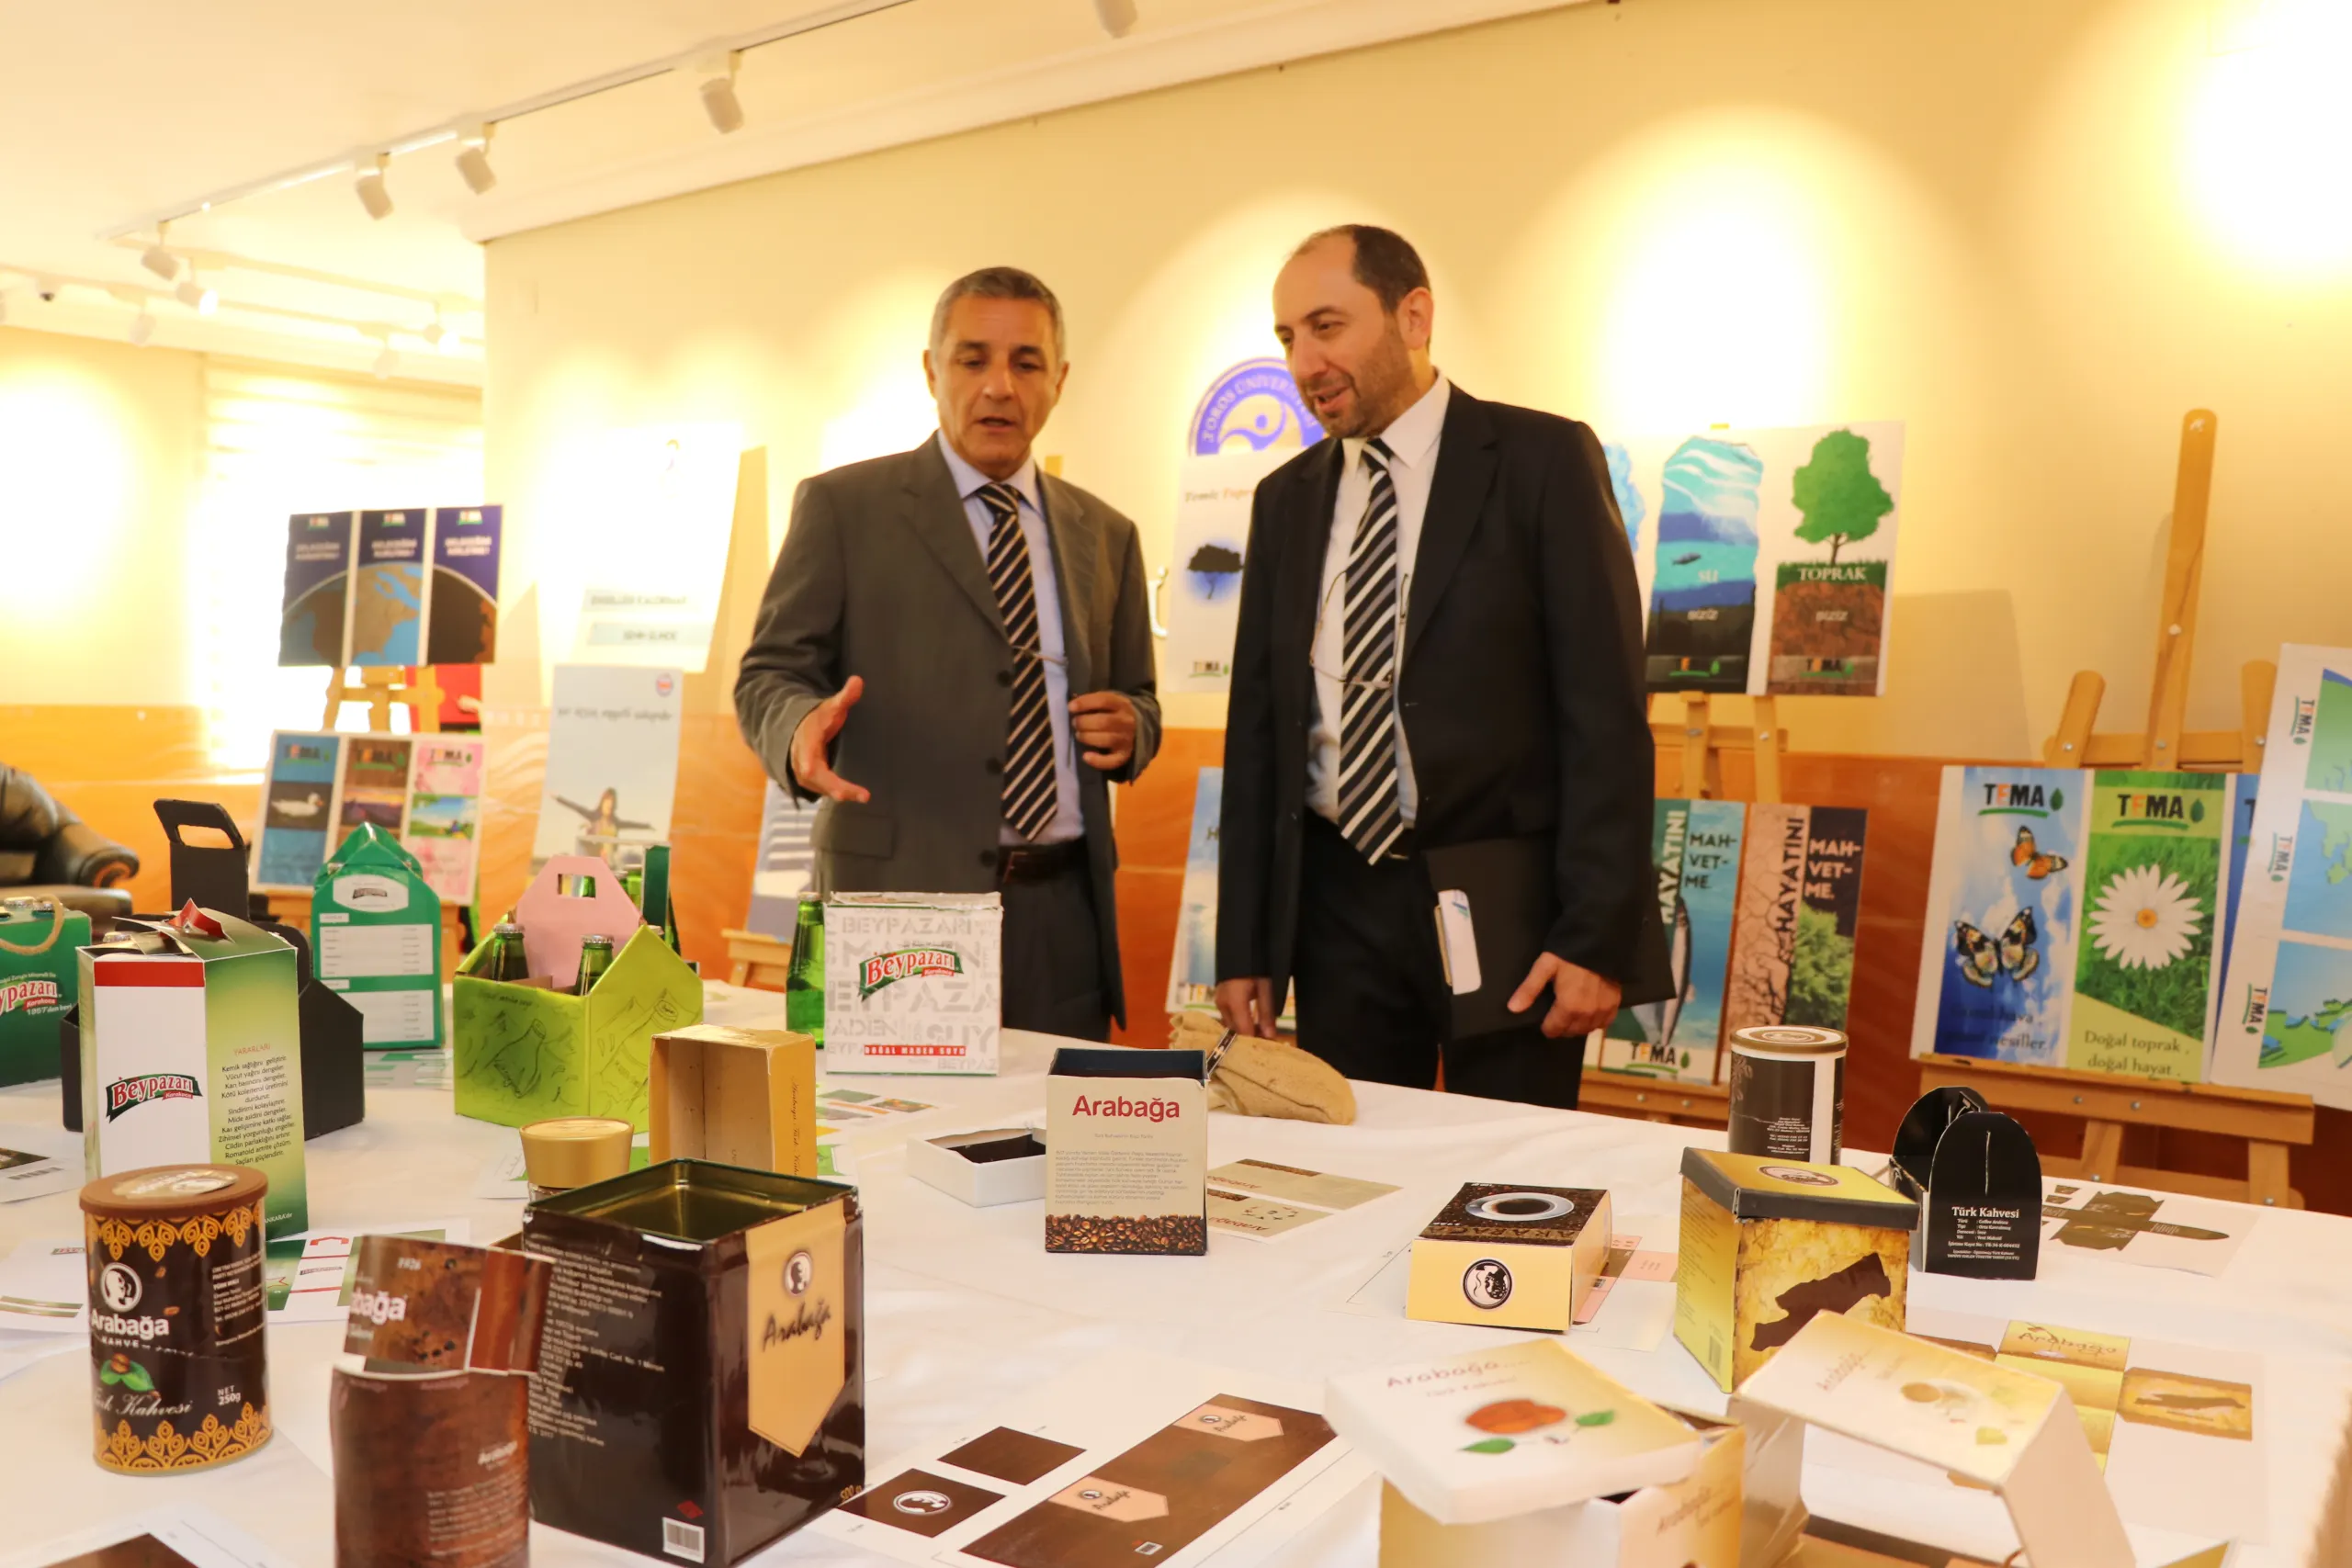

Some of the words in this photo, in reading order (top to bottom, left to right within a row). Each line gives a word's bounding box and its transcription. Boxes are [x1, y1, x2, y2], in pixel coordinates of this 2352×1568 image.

[1797, 568, 1867, 581] TOPRAK
[2296, 699, 2315, 735] TEMA
[1984, 784, 2045, 807] TEMA
[2117, 794, 2184, 819] TEMA
[1689, 833, 1737, 849] MAH-
[1808, 839, 1861, 857] MAH-
[1689, 853, 1728, 869] VET-
[2274, 835, 2294, 873] TEMA
[1775, 818, 1805, 935] HAYATINI
[1808, 861, 1854, 879] VET-
[1805, 883, 1835, 899] ME.
[865, 951, 956, 987] Beypazarı
[2249, 987, 2268, 1025] TEMA
[2085, 1030, 2127, 1050] Doğal
[2132, 1035, 2180, 1055] toprak
[1632, 1043, 1677, 1065] TEMA
[221, 1063, 240, 1073] Kemik
[2087, 1053, 2128, 1073] doğal
[2132, 1059, 2171, 1077] hayat
[225, 1072, 243, 1080] Vücut
[243, 1069, 260, 1078] yağını
[111, 1075, 194, 1110] Beypazarı
[221, 1091, 236, 1100] Kötü
[1072, 1095, 1181, 1122] Arabağa
[227, 1115, 243, 1123] Mide
[218, 1134, 242, 1143] Zihinsel
[224, 1142, 243, 1150] Cildin
[224, 1149, 254, 1158] Romatoid
[1951, 1206, 1977, 1217] Türk
[1979, 1207, 2020, 1218] Kahvesi
[91, 1307, 170, 1340] Arabağa
[101, 1337, 140, 1348] KAHVE
[217, 1384, 235, 1397] NET
[218, 1392, 242, 1407] 250g
[115, 1393, 194, 1416] Kahvesi
